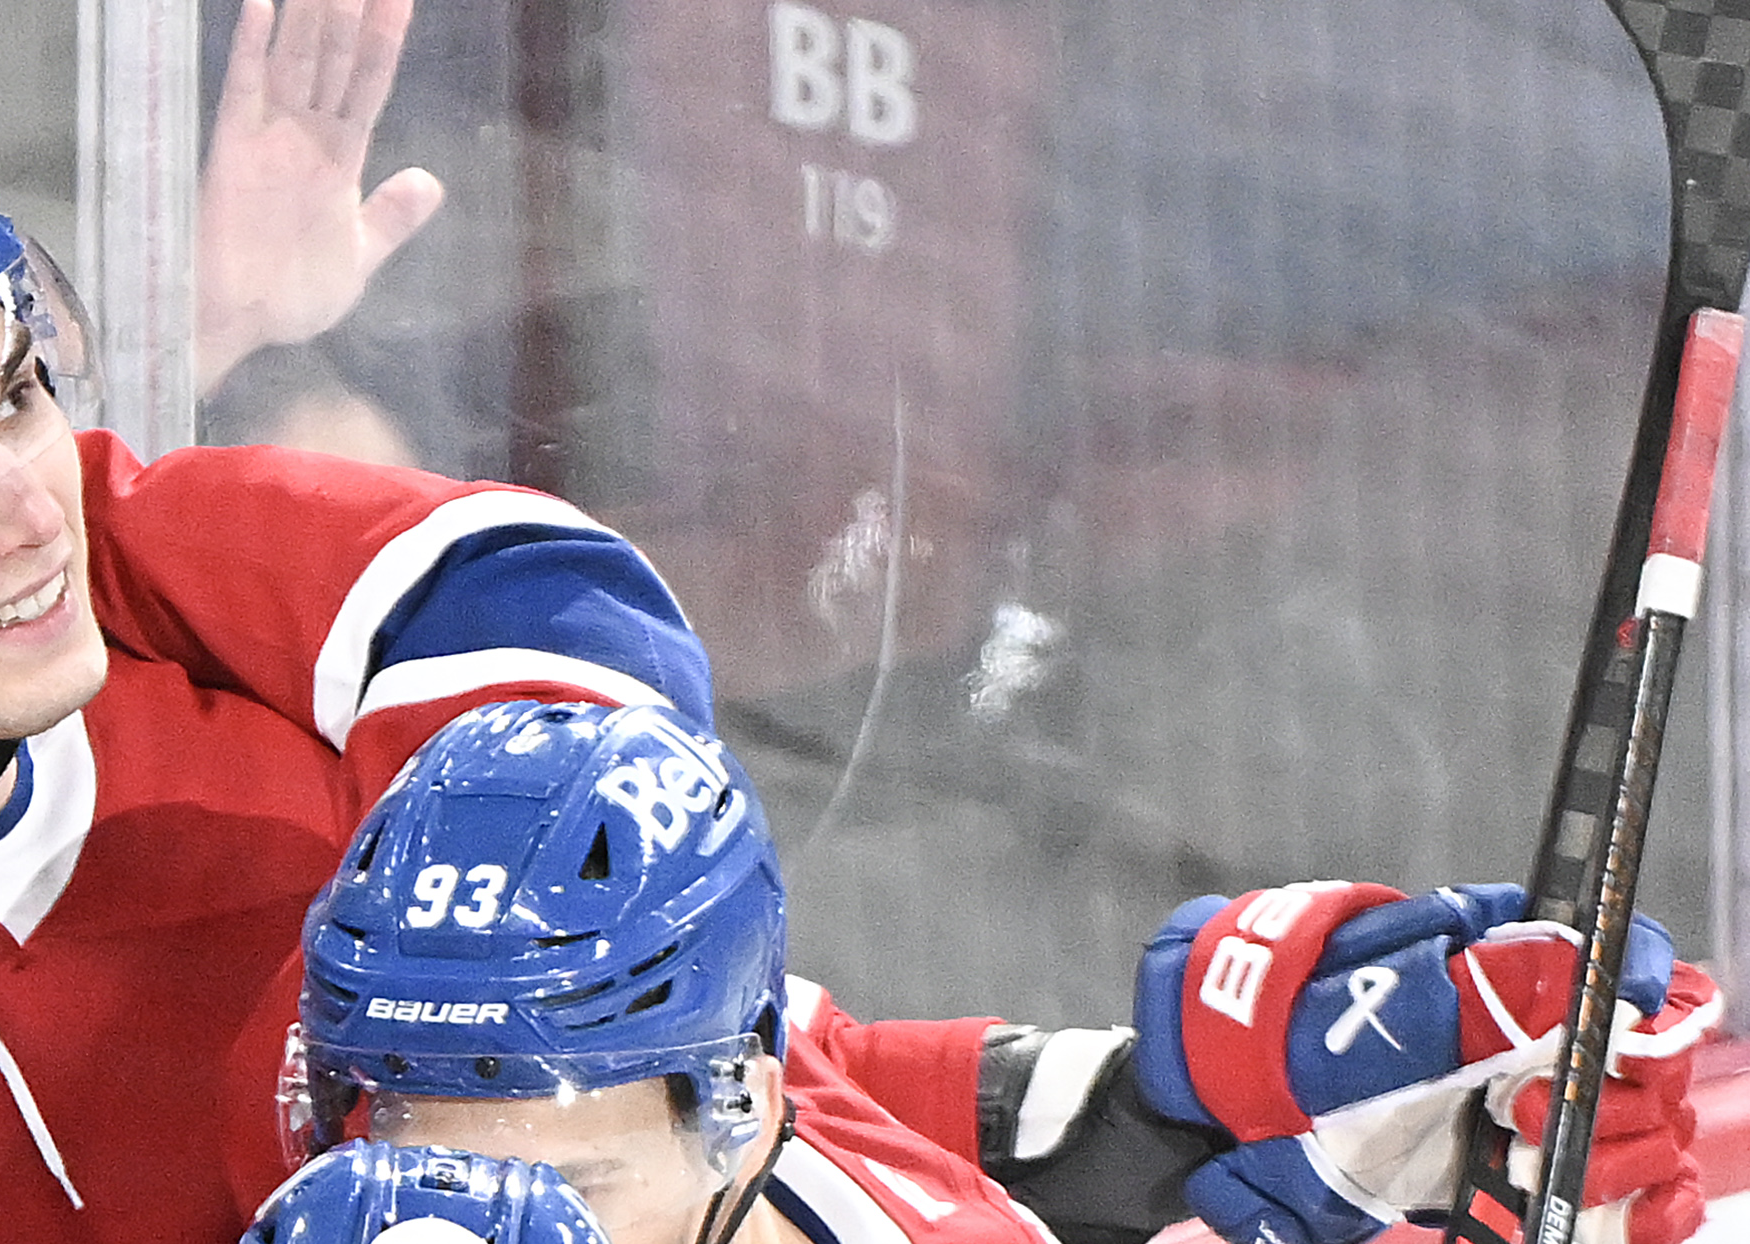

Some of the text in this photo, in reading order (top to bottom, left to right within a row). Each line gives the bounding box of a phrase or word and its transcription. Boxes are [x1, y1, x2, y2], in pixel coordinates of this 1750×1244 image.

[767, 2, 921, 147] BB
[405, 863, 509, 929] 93
[365, 996, 509, 1024] BAUER
